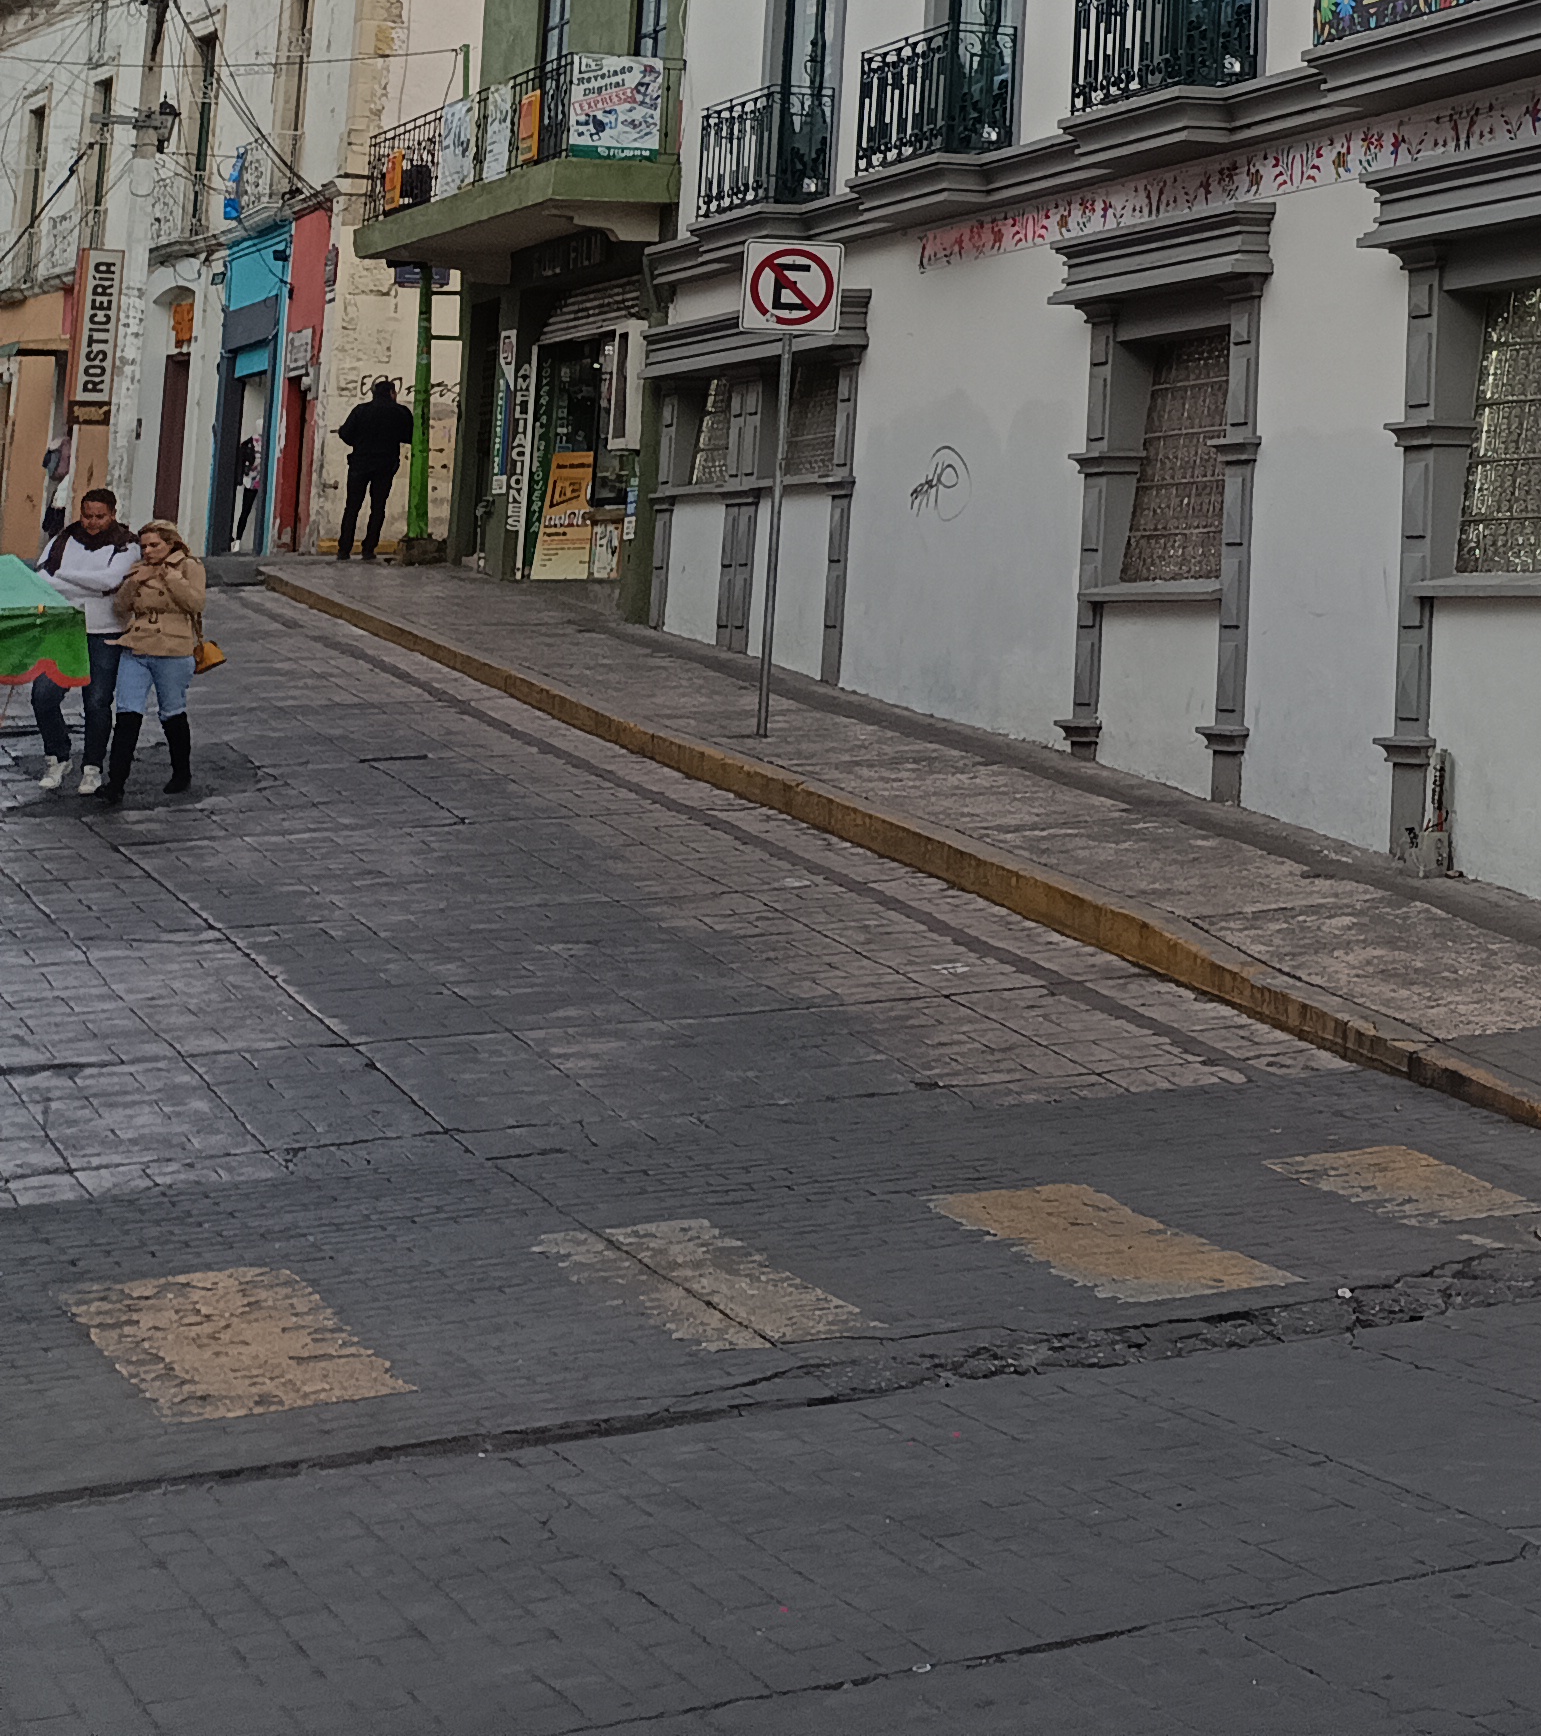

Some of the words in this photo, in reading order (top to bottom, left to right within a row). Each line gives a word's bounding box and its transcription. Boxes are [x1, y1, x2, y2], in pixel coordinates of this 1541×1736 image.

[577, 65, 634, 86] Revelado
[583, 78, 625, 97] Digital
[506, 363, 531, 531] AMPLIACIONES
